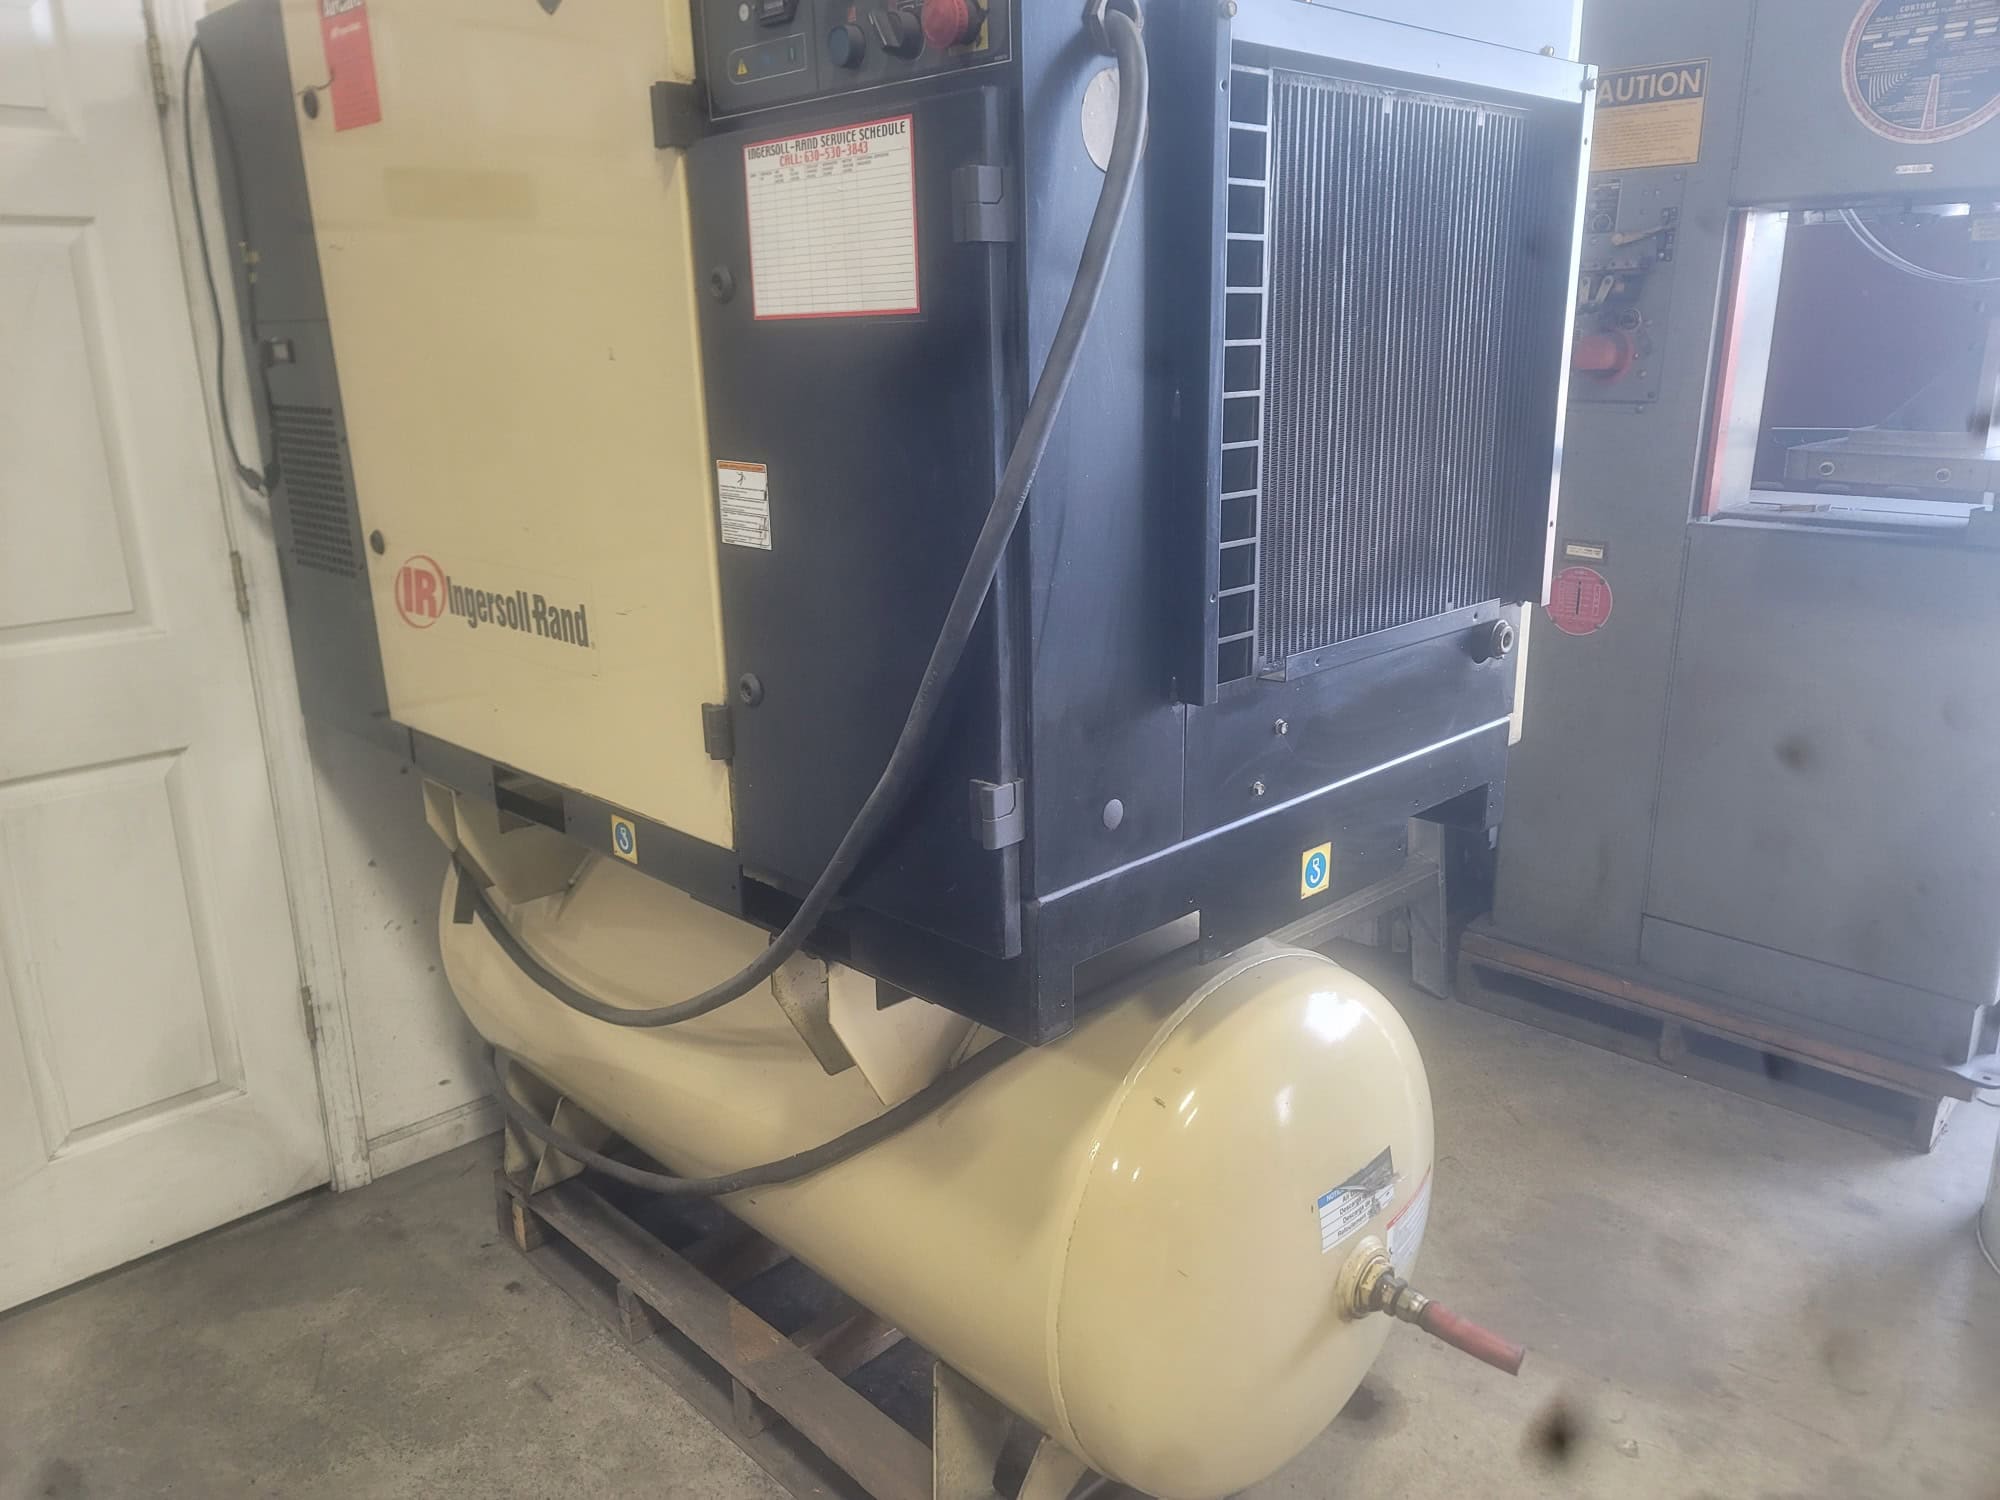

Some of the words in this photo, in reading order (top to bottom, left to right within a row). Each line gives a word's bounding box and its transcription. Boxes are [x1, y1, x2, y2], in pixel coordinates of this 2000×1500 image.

[1596, 68, 1702, 104] AUTION
[747, 136, 818, 160] INGERSOLL-RAND
[820, 129, 857, 147] SERVICE
[859, 120, 906, 141] SCHEDULE
[779, 152, 803, 167] CALL:
[402, 566, 439, 619] IR
